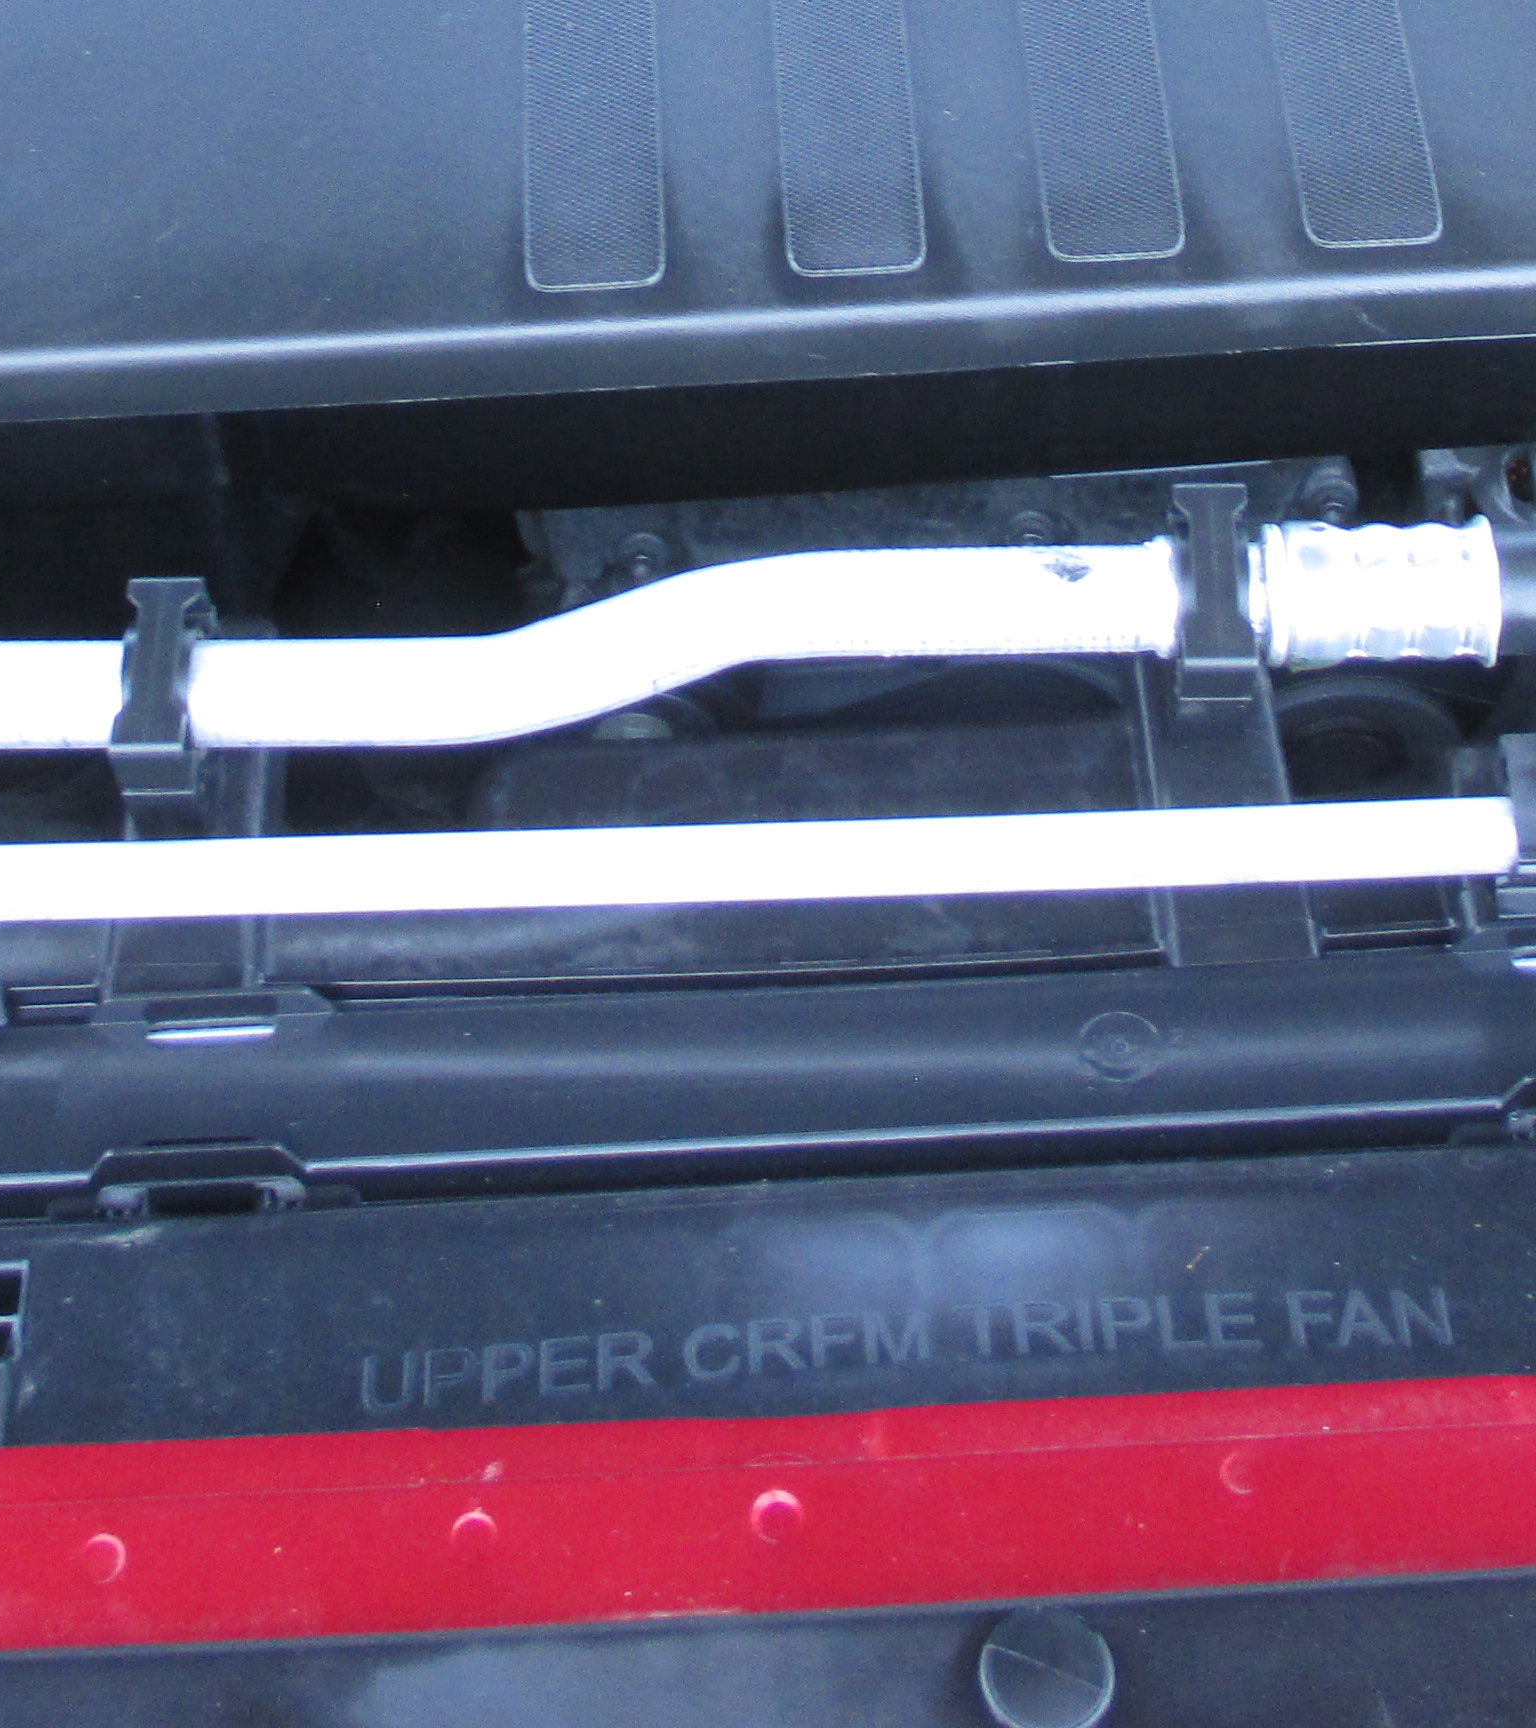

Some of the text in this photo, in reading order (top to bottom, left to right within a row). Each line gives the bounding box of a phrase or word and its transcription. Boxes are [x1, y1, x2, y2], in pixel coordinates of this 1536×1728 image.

[359, 1285, 1457, 1412] UPPER CRFM TRIPLE FAN
